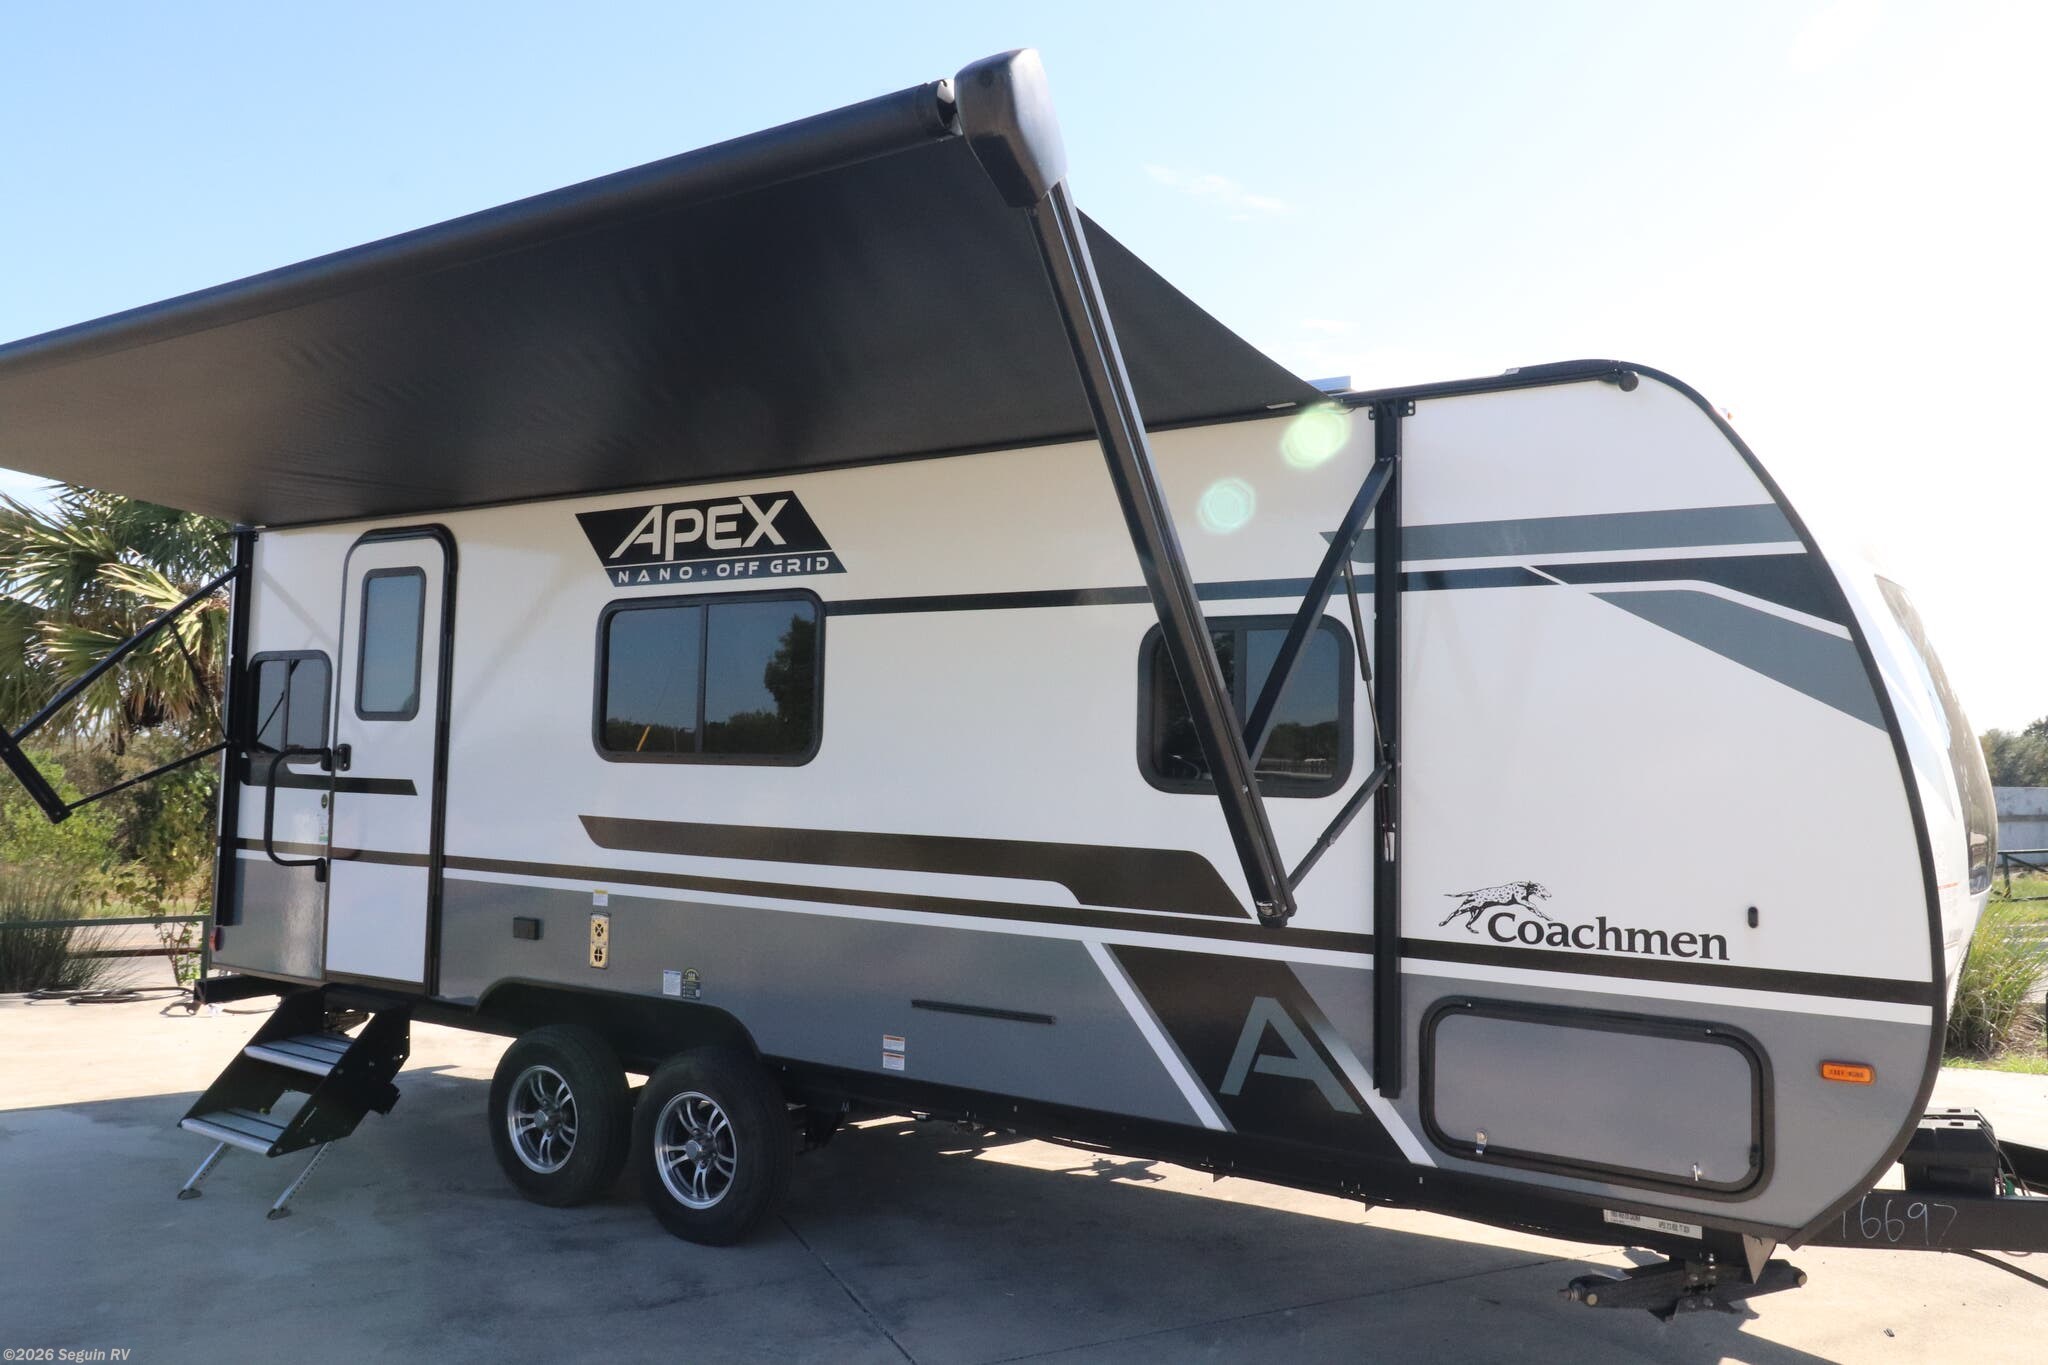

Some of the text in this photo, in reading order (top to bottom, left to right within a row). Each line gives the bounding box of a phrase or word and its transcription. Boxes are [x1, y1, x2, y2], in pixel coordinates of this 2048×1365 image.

[609, 495, 789, 561] APEX
[618, 557, 830, 584] NANO OFF GRID
[1487, 911, 1730, 961] Coachmen
